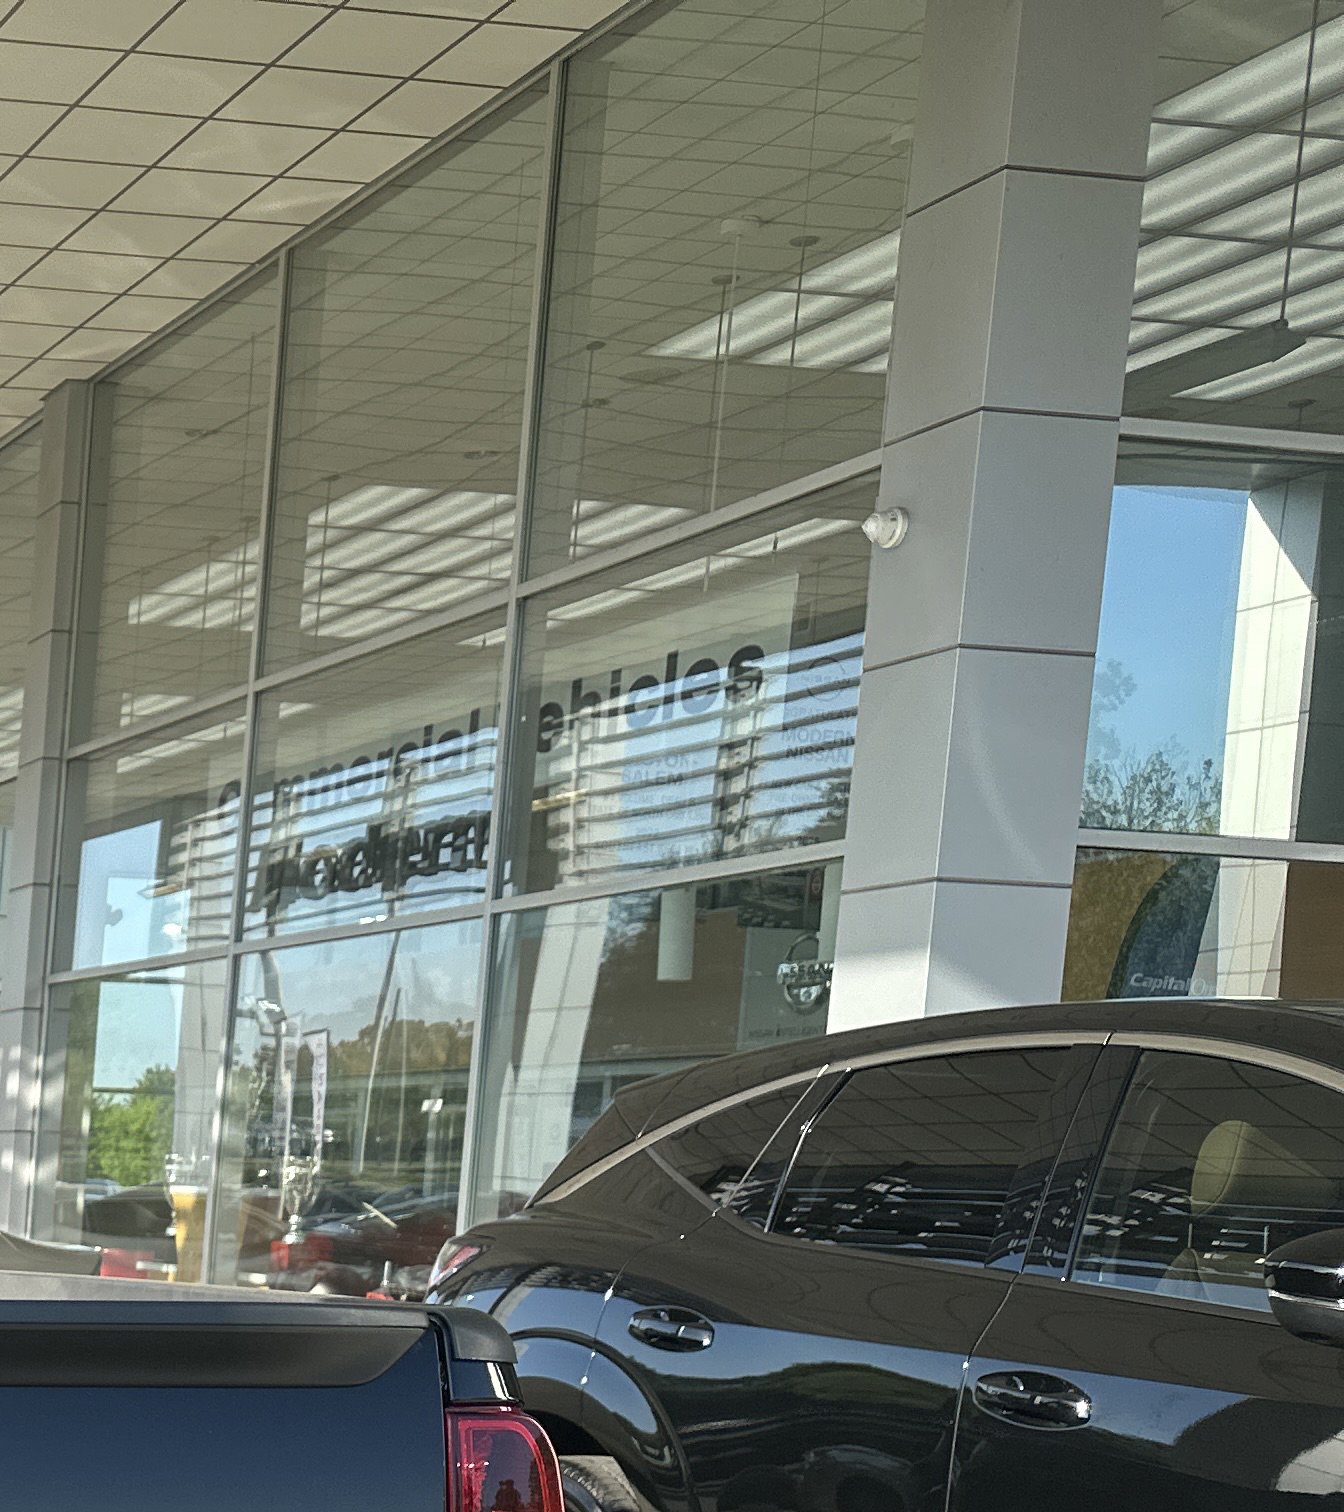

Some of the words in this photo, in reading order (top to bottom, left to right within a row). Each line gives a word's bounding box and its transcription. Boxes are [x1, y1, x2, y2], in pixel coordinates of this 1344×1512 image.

[215, 707, 481, 828] cmmercial
[535, 644, 766, 754] ehicles
[1130, 972, 1189, 993] Capital
